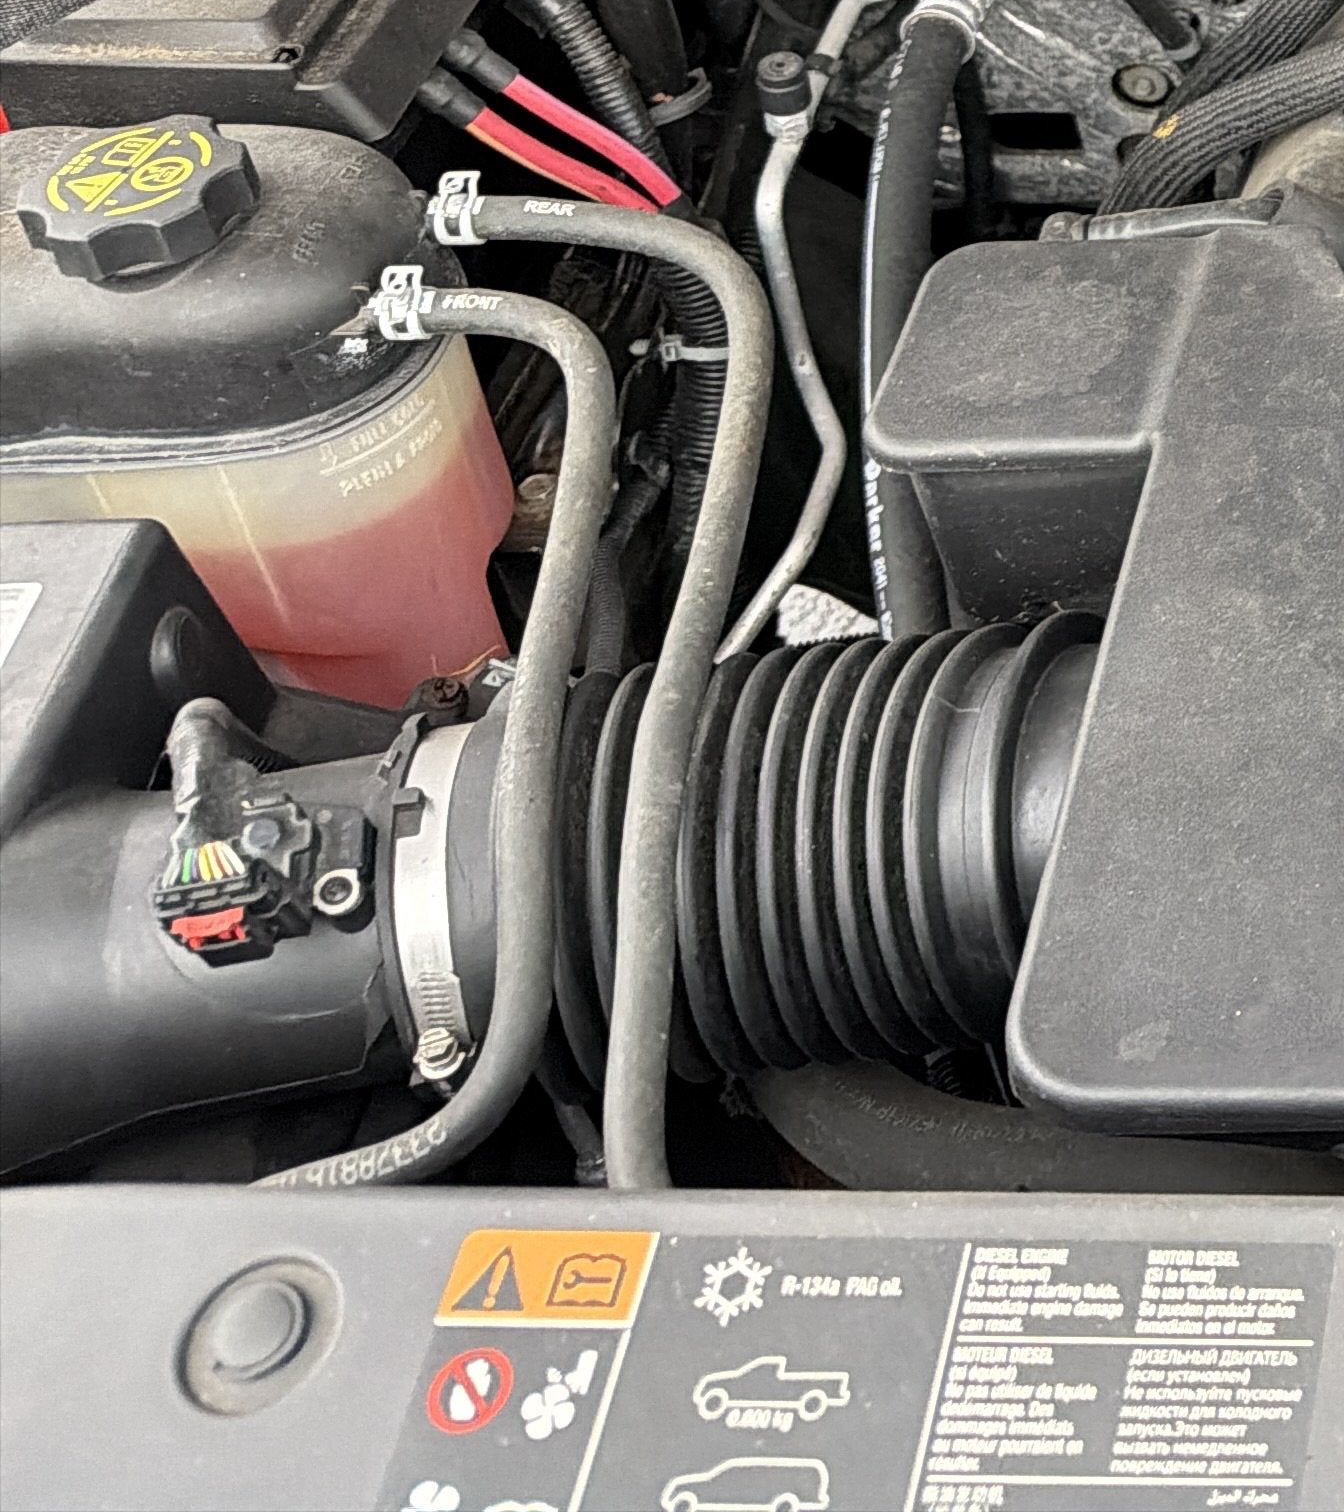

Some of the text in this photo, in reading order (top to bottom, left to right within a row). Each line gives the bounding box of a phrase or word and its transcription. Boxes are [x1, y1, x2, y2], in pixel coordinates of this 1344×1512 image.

[523, 199, 577, 217] REAR
[441, 293, 505, 311] FRONT
[1148, 1249, 1240, 1267] MOTOR DIESEL
[780, 1274, 841, 1296] R-134a
[845, 1275, 879, 1296] PAG
[986, 1283, 1009, 1298] not
[1033, 1282, 1082, 1301] starting
[958, 1318, 984, 1332] can
[951, 1346, 1054, 1364] MOTEUR DIESEL
[1128, 1348, 1298, 1367] ДИЗЕЛЬНЫЙ ДВИГАТЕЛЬ
